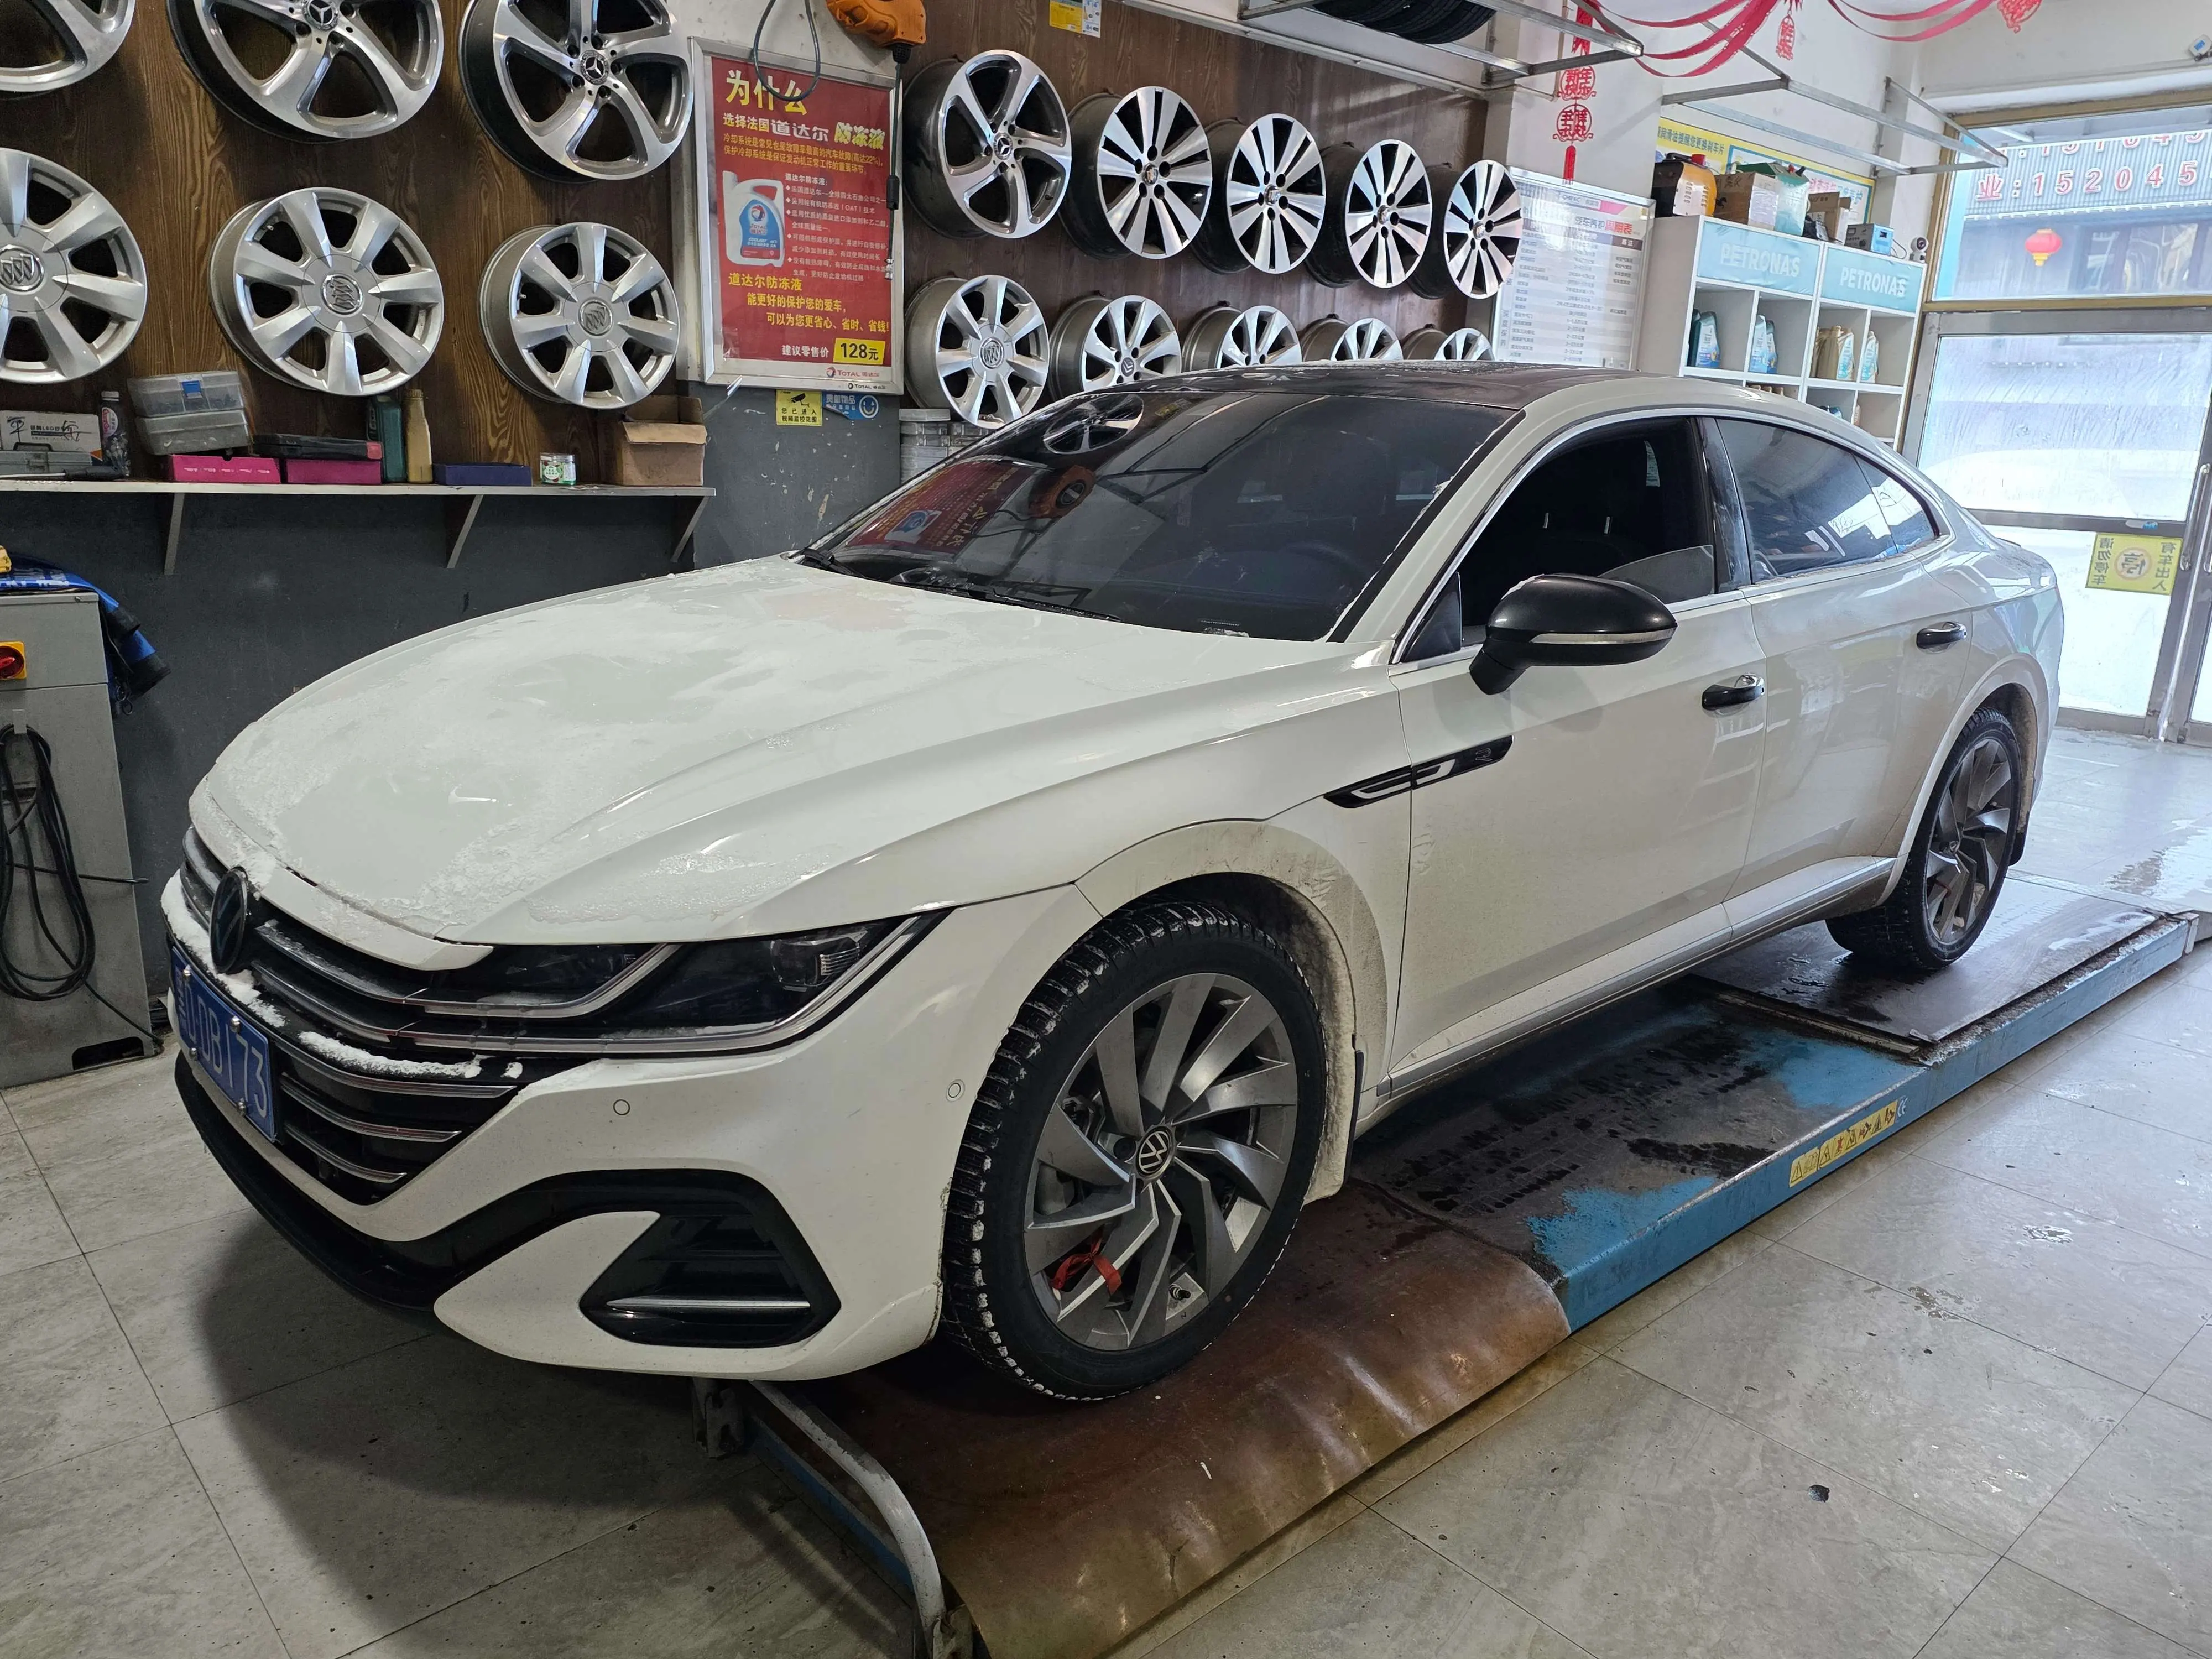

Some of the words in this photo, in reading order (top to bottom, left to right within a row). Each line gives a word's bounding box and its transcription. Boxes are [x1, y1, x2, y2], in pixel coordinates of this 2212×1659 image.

[726, 70, 807, 116] 为什么
[723, 113, 829, 142] 选择法国道达尔
[834, 122, 886, 150] 防冻液
[1720, 242, 1801, 278] PETRONAS
[728, 273, 802, 291] 道达尔防冻液
[1840, 267, 1907, 297] PETRONAS
[781, 345, 830, 358] 建议零售价
[840, 342, 879, 361] 128元
